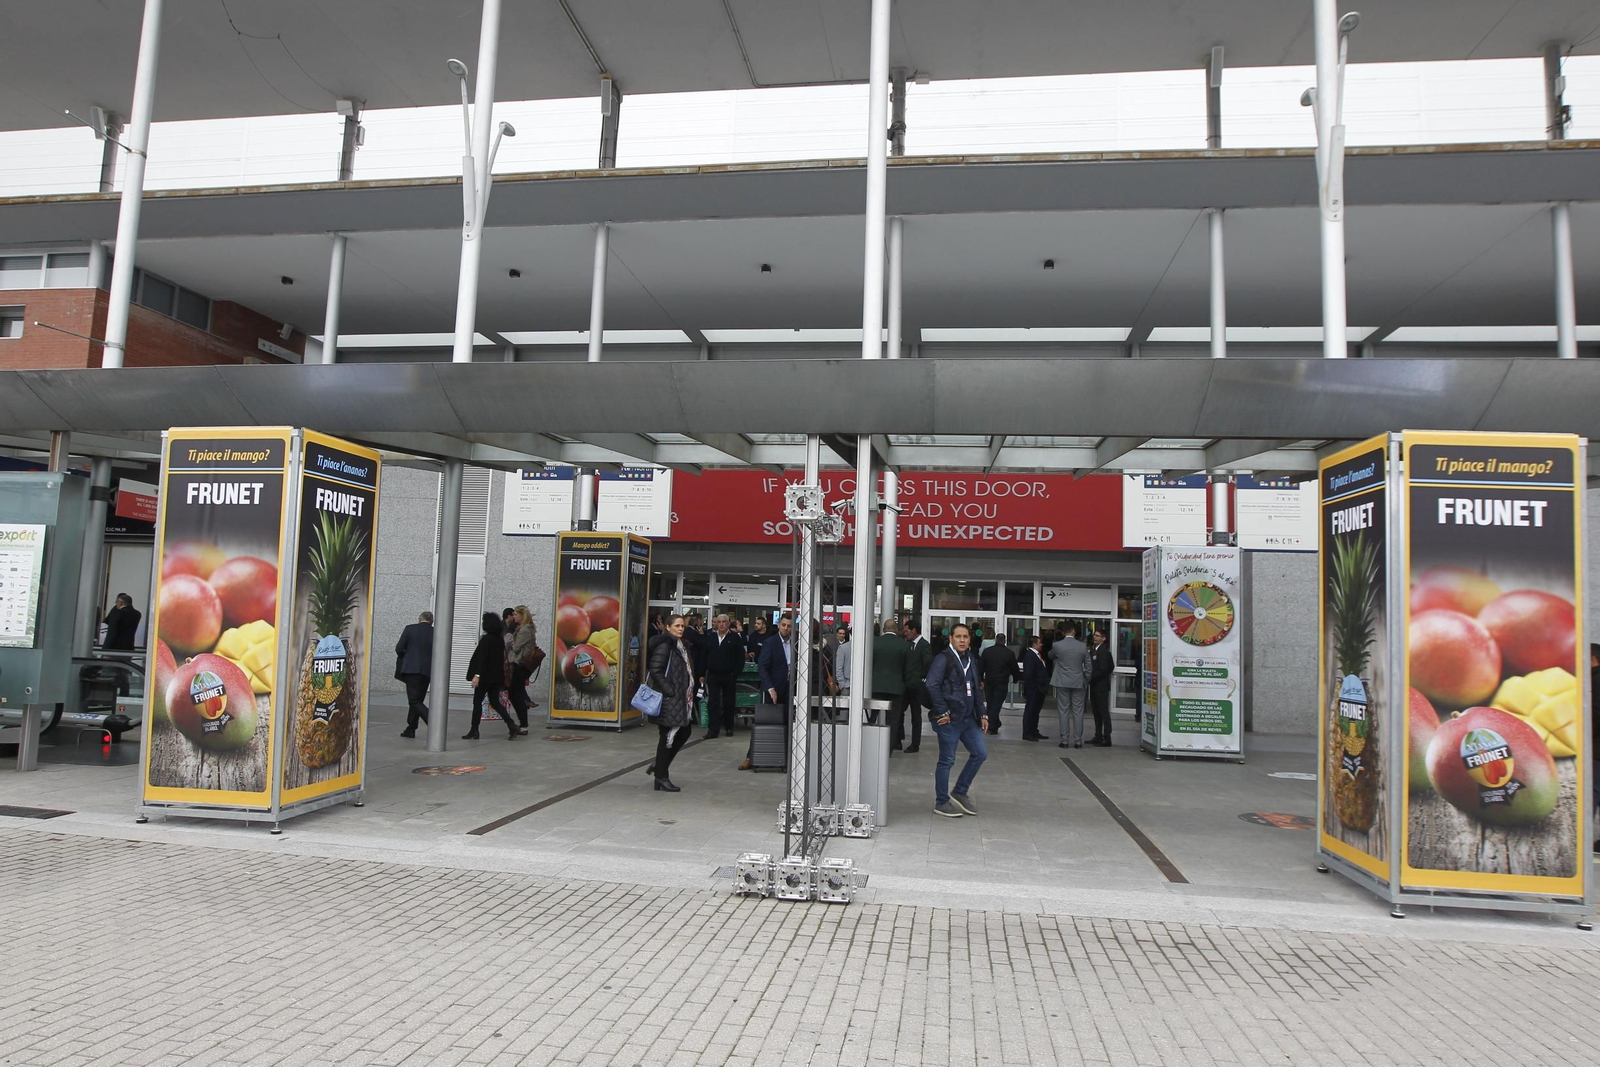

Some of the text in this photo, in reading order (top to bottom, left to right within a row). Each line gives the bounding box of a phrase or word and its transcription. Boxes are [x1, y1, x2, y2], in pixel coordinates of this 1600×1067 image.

[188, 449, 270, 464] Ti piace il mango?
[317, 454, 323, 466] Ti
[322, 458, 340, 470] piace
[1436, 458, 1554, 478] Ti piace il mango?
[763, 478, 778, 493] IF
[922, 480, 968, 496] THIS
[975, 480, 1050, 499] DOOR,
[1330, 476, 1335, 490] Ti
[1334, 474, 1348, 491] piace
[187, 483, 264, 504] FRUNET
[316, 488, 364, 516] FRUNET
[898, 502, 998, 518] EAD YOU
[1332, 502, 1374, 535] FRUNET
[1438, 498, 1548, 526] FRUNET
[908, 524, 1054, 542] UNEXPECTED
[570, 559, 612, 570] FRUNET
[1174, 553, 1202, 561] Solidaridad
[631, 562, 646, 575] FRUNET
[1165, 568, 1182, 585] Ruleta
[1183, 566, 1209, 576] Solidaria
[314, 659, 344, 674] FRUNET
[194, 686, 224, 704] FRUNET
[1340, 702, 1366, 720] FRUNET
[1466, 747, 1508, 768] FRUNET
